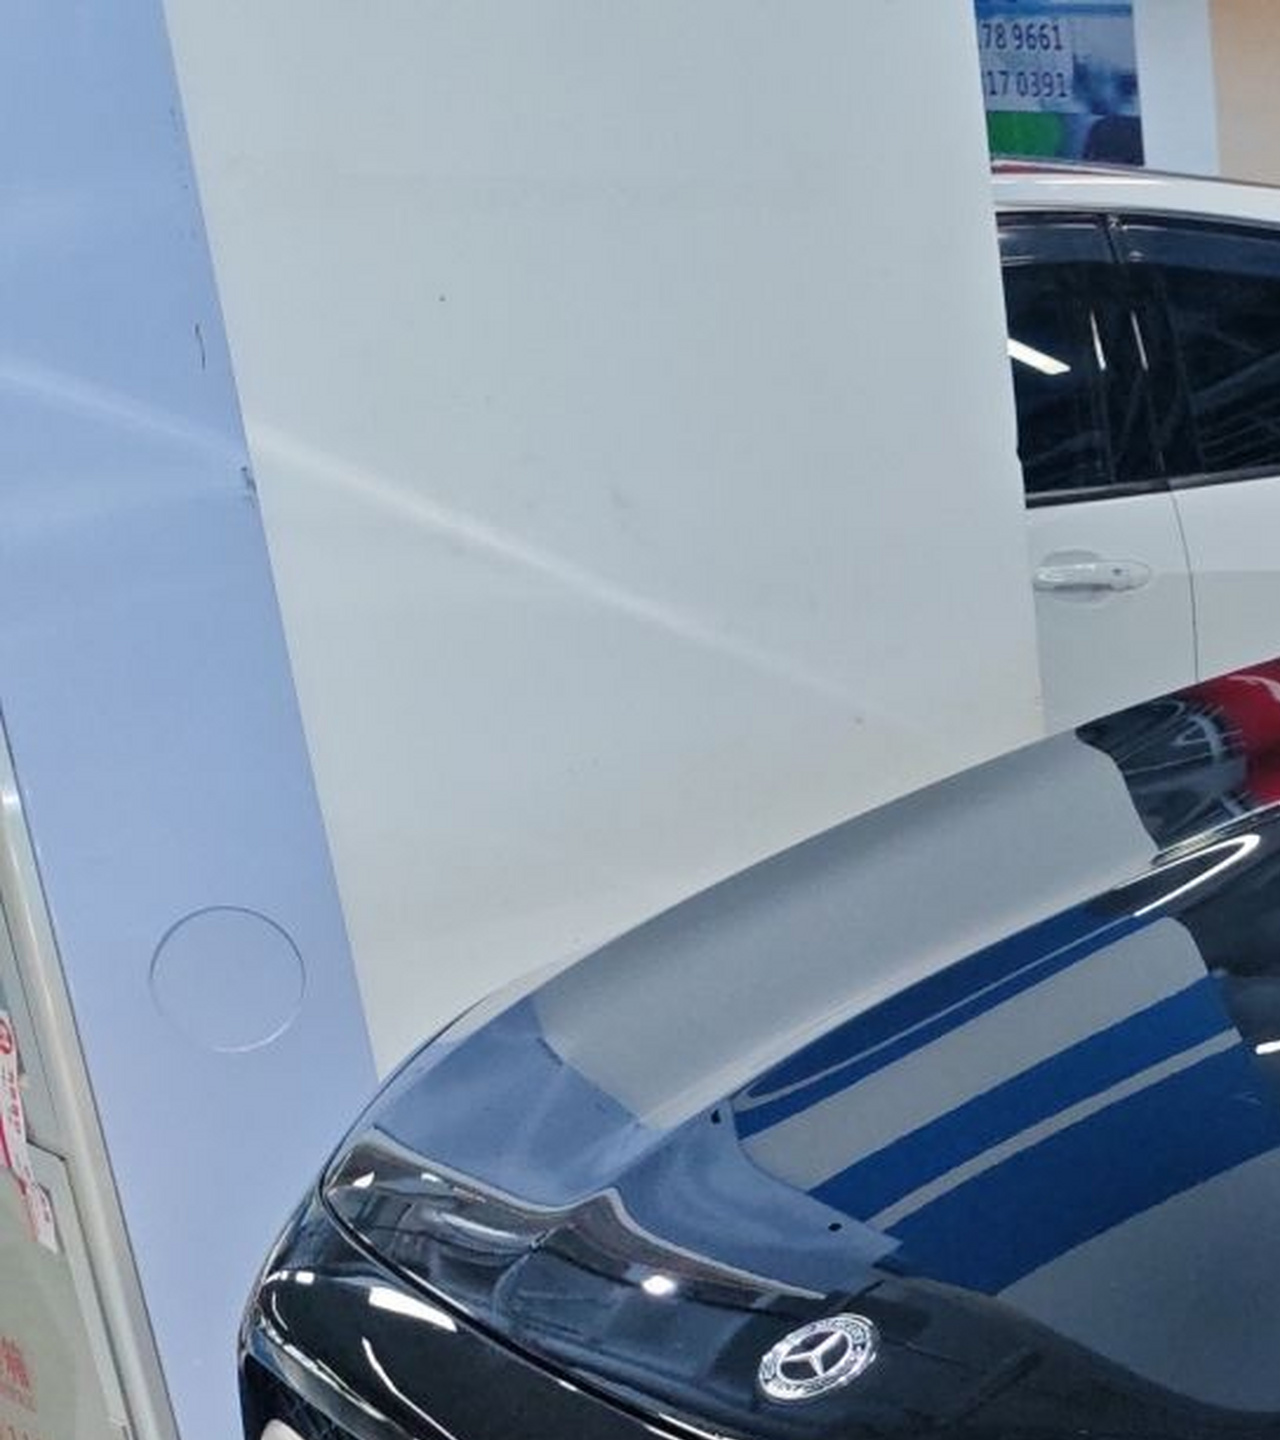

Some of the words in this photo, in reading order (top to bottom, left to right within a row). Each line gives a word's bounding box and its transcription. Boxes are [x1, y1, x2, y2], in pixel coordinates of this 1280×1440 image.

[979, 22, 1007, 50] 78
[1012, 22, 1063, 51] 9661
[982, 69, 1010, 97] 17
[1016, 70, 1069, 98] 0391
